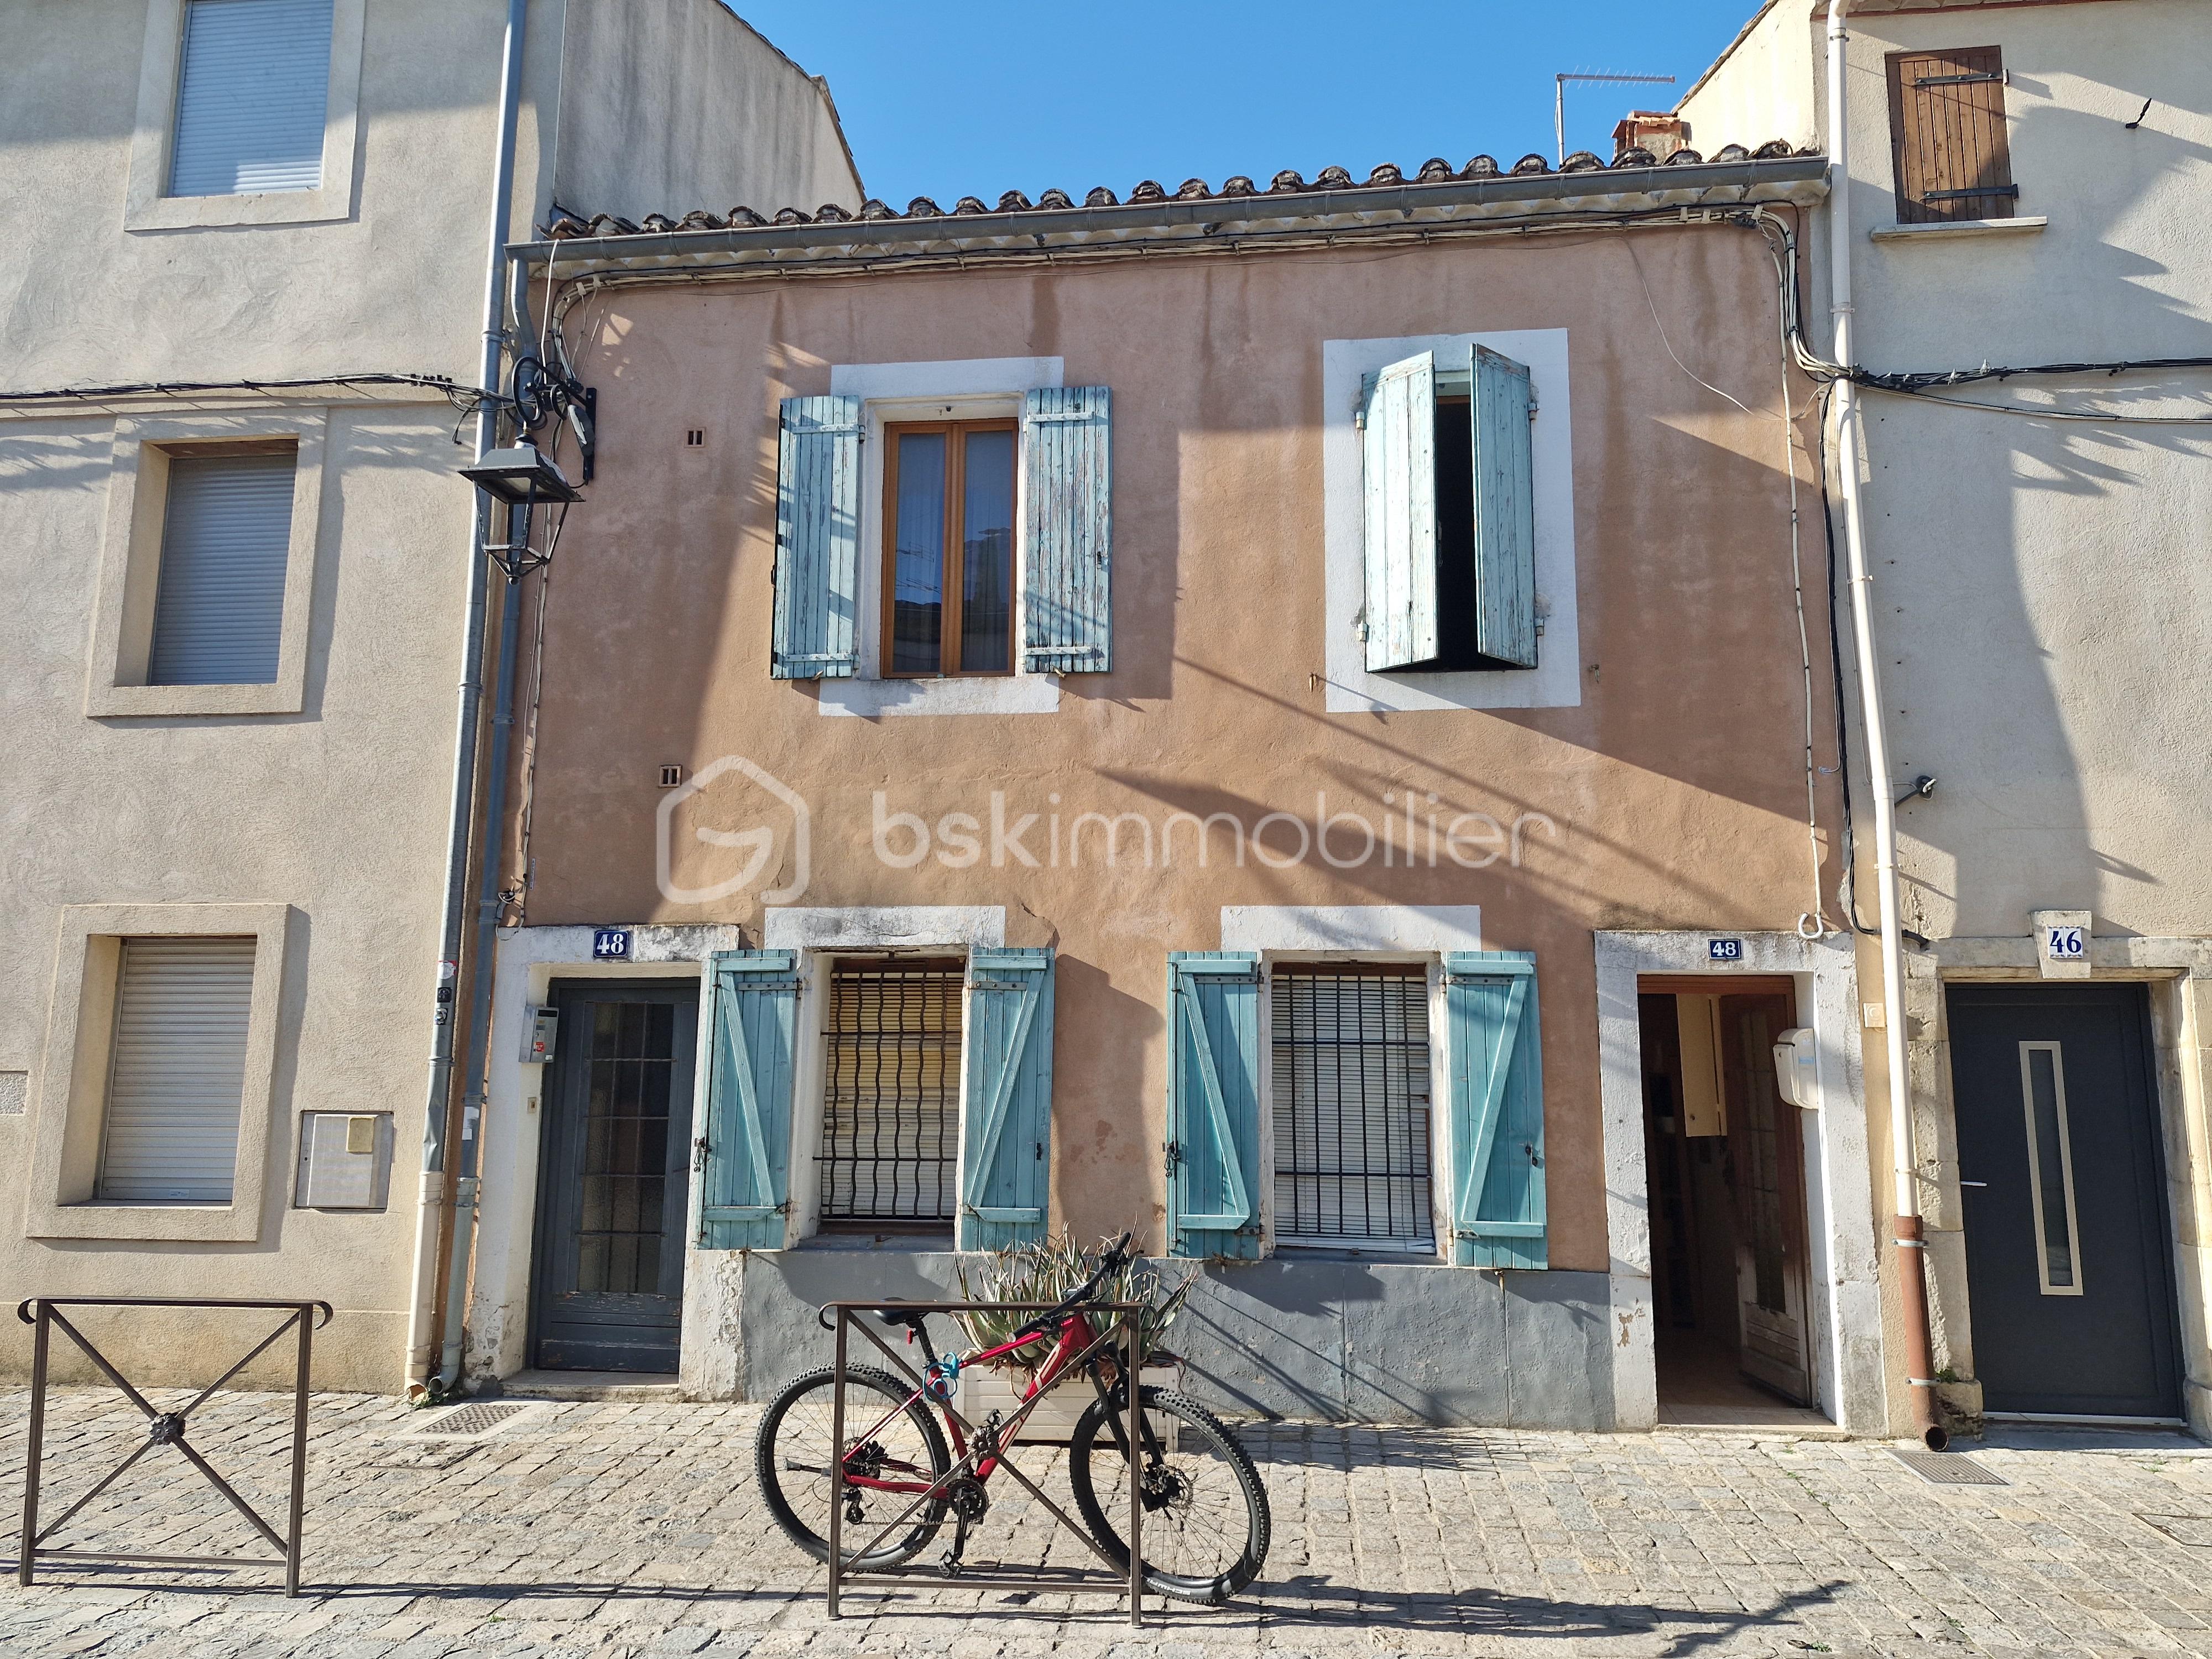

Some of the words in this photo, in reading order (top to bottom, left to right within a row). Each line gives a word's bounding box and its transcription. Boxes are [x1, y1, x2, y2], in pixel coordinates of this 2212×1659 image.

[597, 933, 624, 954] 48
[1713, 942, 1736, 956] 48
[2050, 931, 2082, 953] 46
